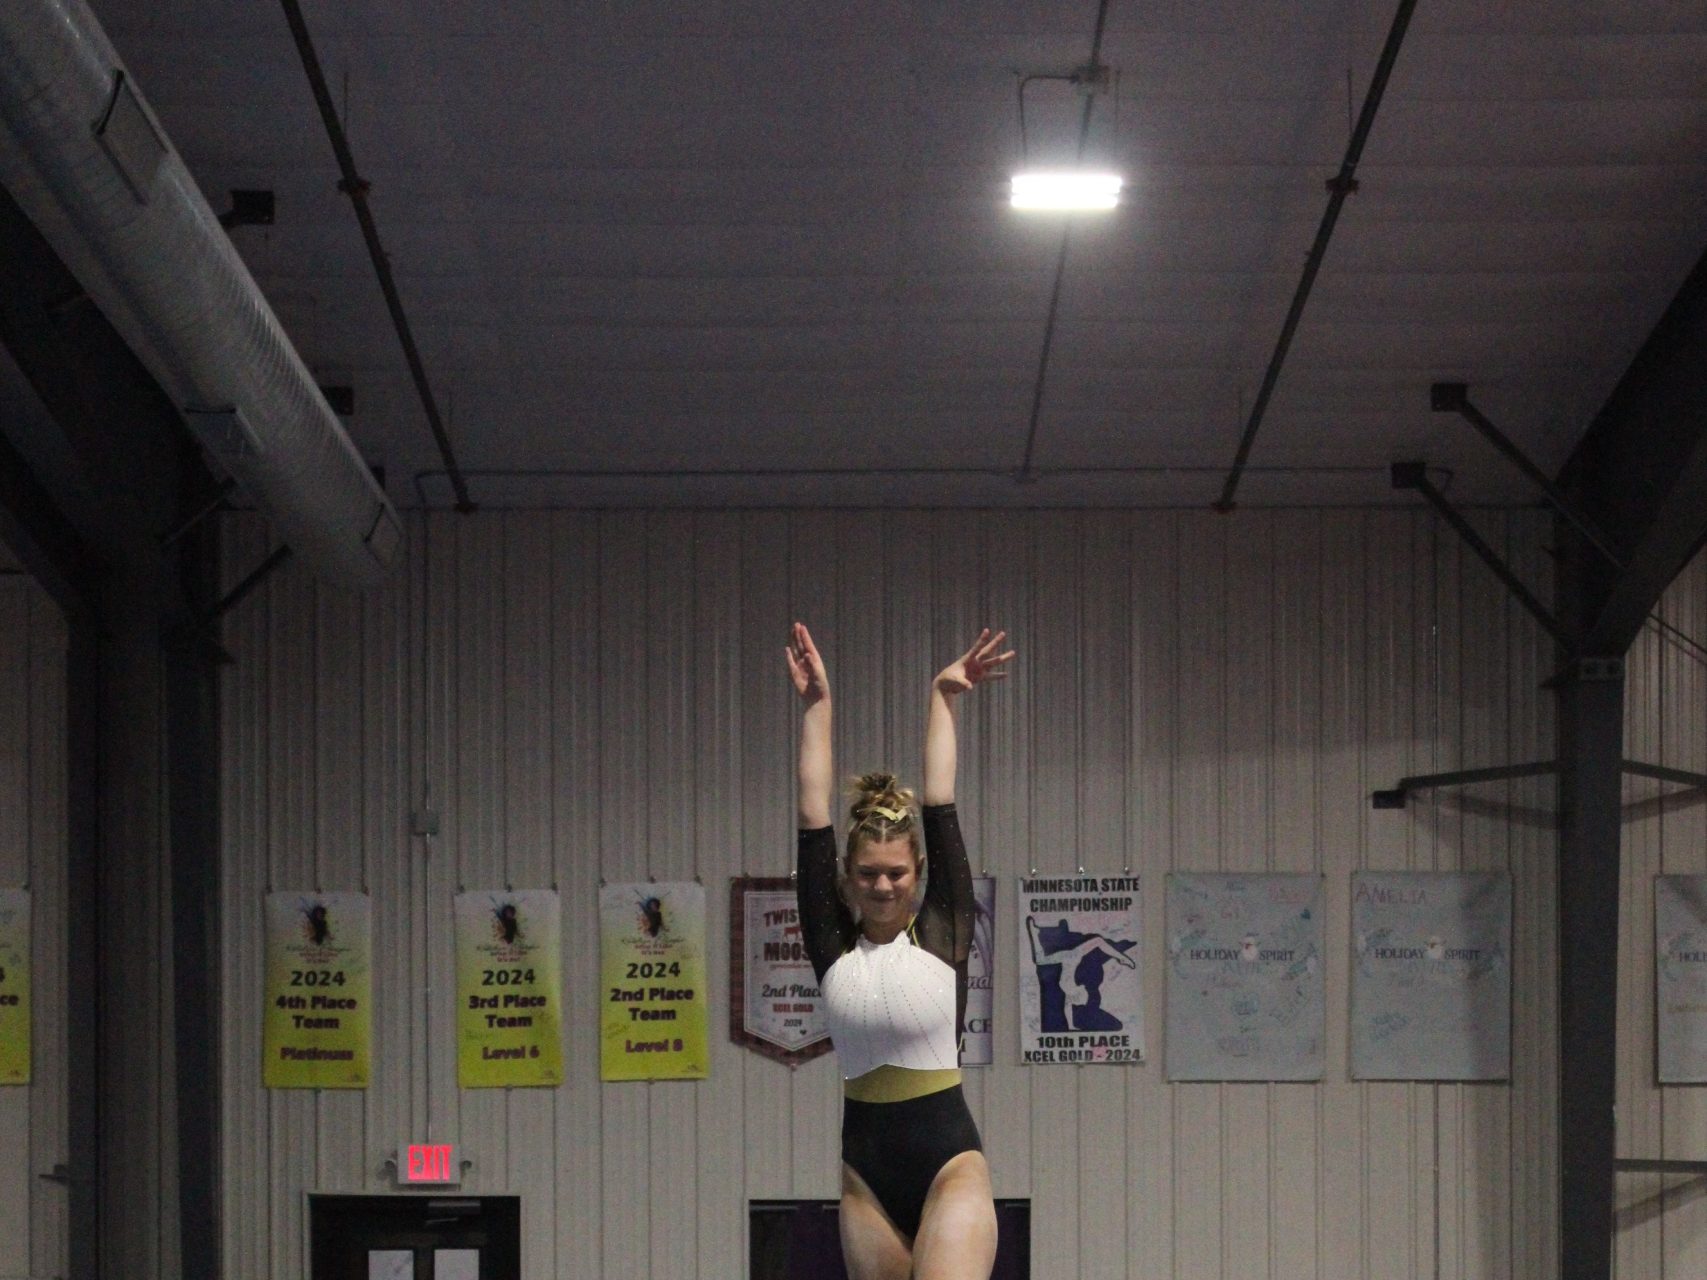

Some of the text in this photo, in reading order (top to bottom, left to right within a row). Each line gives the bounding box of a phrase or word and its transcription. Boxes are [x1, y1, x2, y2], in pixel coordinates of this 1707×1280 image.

[1022, 877, 1140, 893] MINNESOTA STATE
[1029, 897, 1133, 913] CHAMPIONSHIP
[763, 908, 798, 927] TWIS
[763, 942, 810, 962] MOOS
[1190, 949, 1295, 961] HOLIDAY SPIRIT
[1375, 948, 1480, 961] HOLIDAY SPIRIT
[482, 969, 536, 986] 2024
[626, 962, 681, 979] 2024
[290, 970, 346, 987] 2024
[610, 987, 694, 1002] 2nd Place
[762, 984, 786, 998] 2nd
[276, 995, 357, 1010] 4th Place
[468, 994, 546, 1009] 3rd Place
[485, 1014, 533, 1028] Team
[628, 1007, 676, 1021] Team
[292, 1015, 339, 1029] Team
[625, 1039, 669, 1053] Level
[1037, 1035, 1130, 1049] 10th PLACE
[279, 1047, 354, 1061] Platinum
[482, 1045, 540, 1060] Level 6
[1024, 1050, 1056, 1062] XCEL
[1058, 1049, 1093, 1062] GOLD
[1105, 1049, 1141, 1061] 2024
[408, 1143, 454, 1181] EXIT
